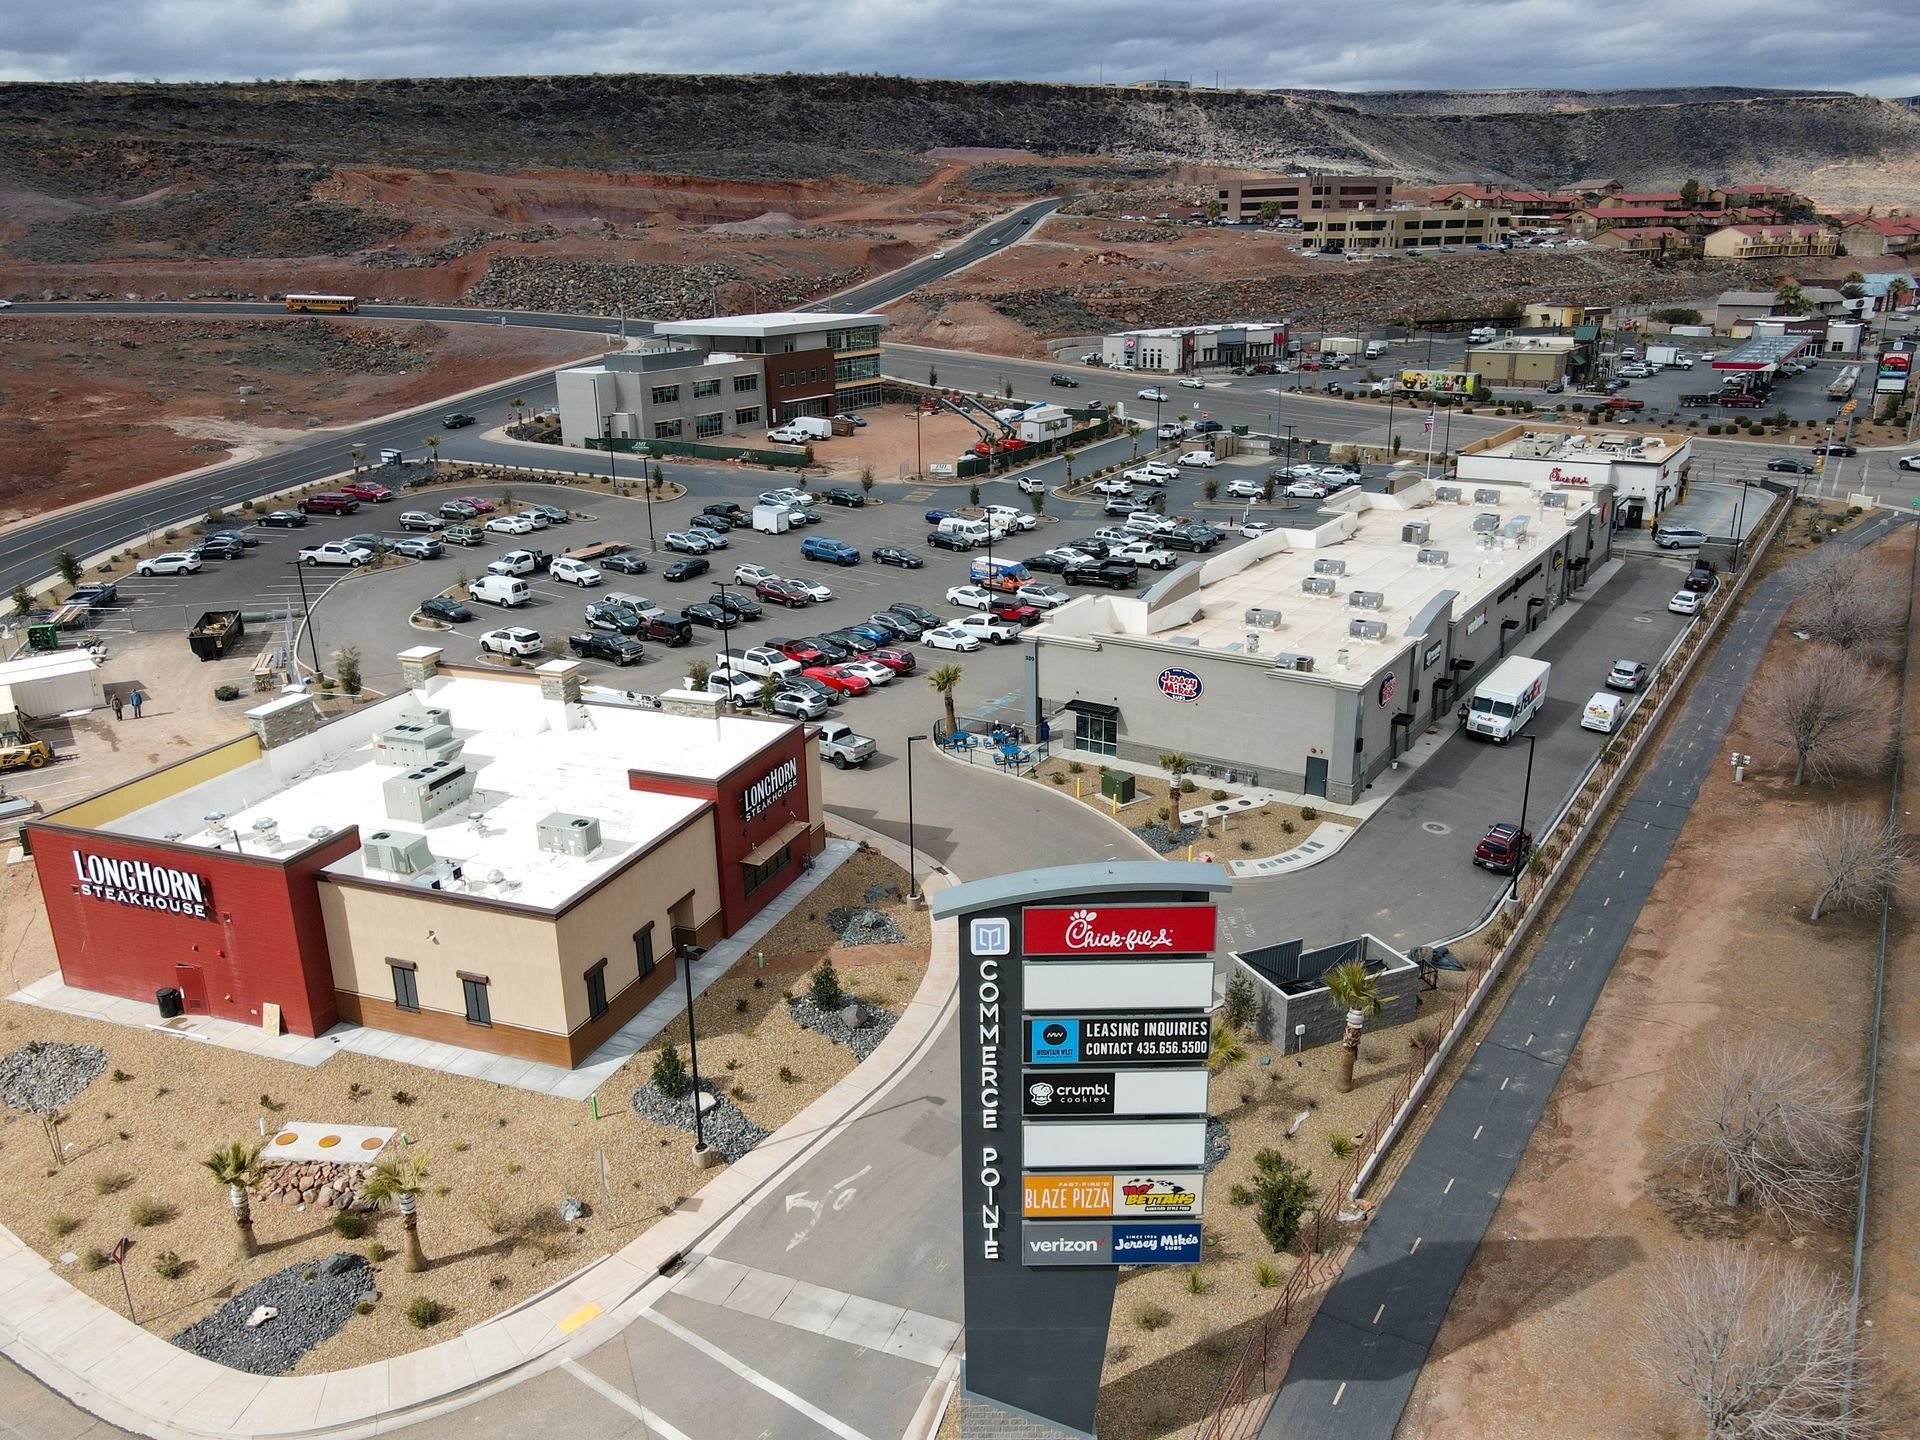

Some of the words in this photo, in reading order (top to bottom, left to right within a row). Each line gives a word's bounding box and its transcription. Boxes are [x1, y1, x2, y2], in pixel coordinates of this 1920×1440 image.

[1160, 671, 1198, 690] Jersey
[1477, 714, 1498, 723] FedEx
[744, 757, 797, 812] LONGHORN
[745, 778, 798, 822] STEAKHOUSE
[73, 850, 203, 903] LONGHORN
[81, 884, 206, 918] STEAKHOUSE
[1065, 910, 1173, 950] Chick-fil-A
[1086, 1023, 1139, 1037] LEASING
[1144, 1021, 1208, 1036] INQUIRIES
[979, 960, 1000, 1129] COMMERCE
[1061, 1048, 1073, 1056] WEST
[1086, 1042, 1134, 1055] CONTACT
[1137, 1041, 1207, 1055] 435.656.5500
[1056, 1084, 1110, 1096] crumbl
[981, 1147, 1001, 1259] POINTE
[1025, 1189, 1068, 1209] BLAZE
[1073, 1188, 1110, 1208] PIZZA
[1125, 1193, 1196, 1205] BETTAHS
[1030, 1238, 1098, 1252] verizon
[1114, 1239, 1158, 1250] Jersey
[1160, 1234, 1199, 1247] Mike's
